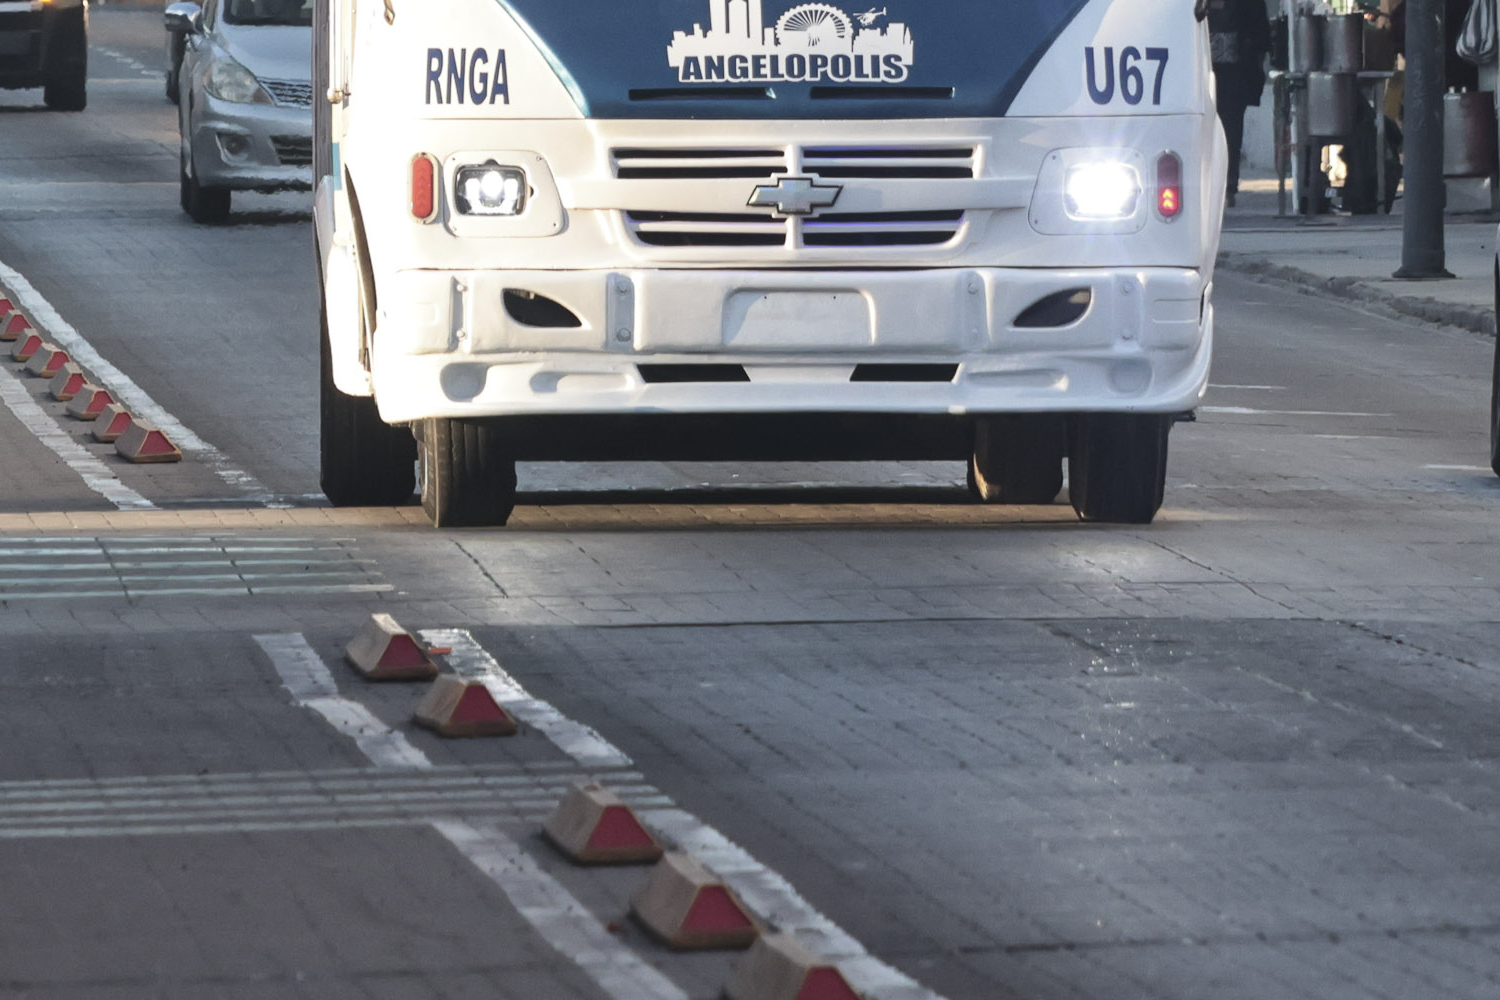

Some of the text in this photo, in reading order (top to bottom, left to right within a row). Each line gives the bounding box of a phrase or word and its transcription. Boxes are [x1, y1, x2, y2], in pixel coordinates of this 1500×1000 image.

[425, 47, 510, 106] RNGA
[681, 54, 905, 81] ANGELOPOLIS
[1084, 46, 1169, 106] U67
